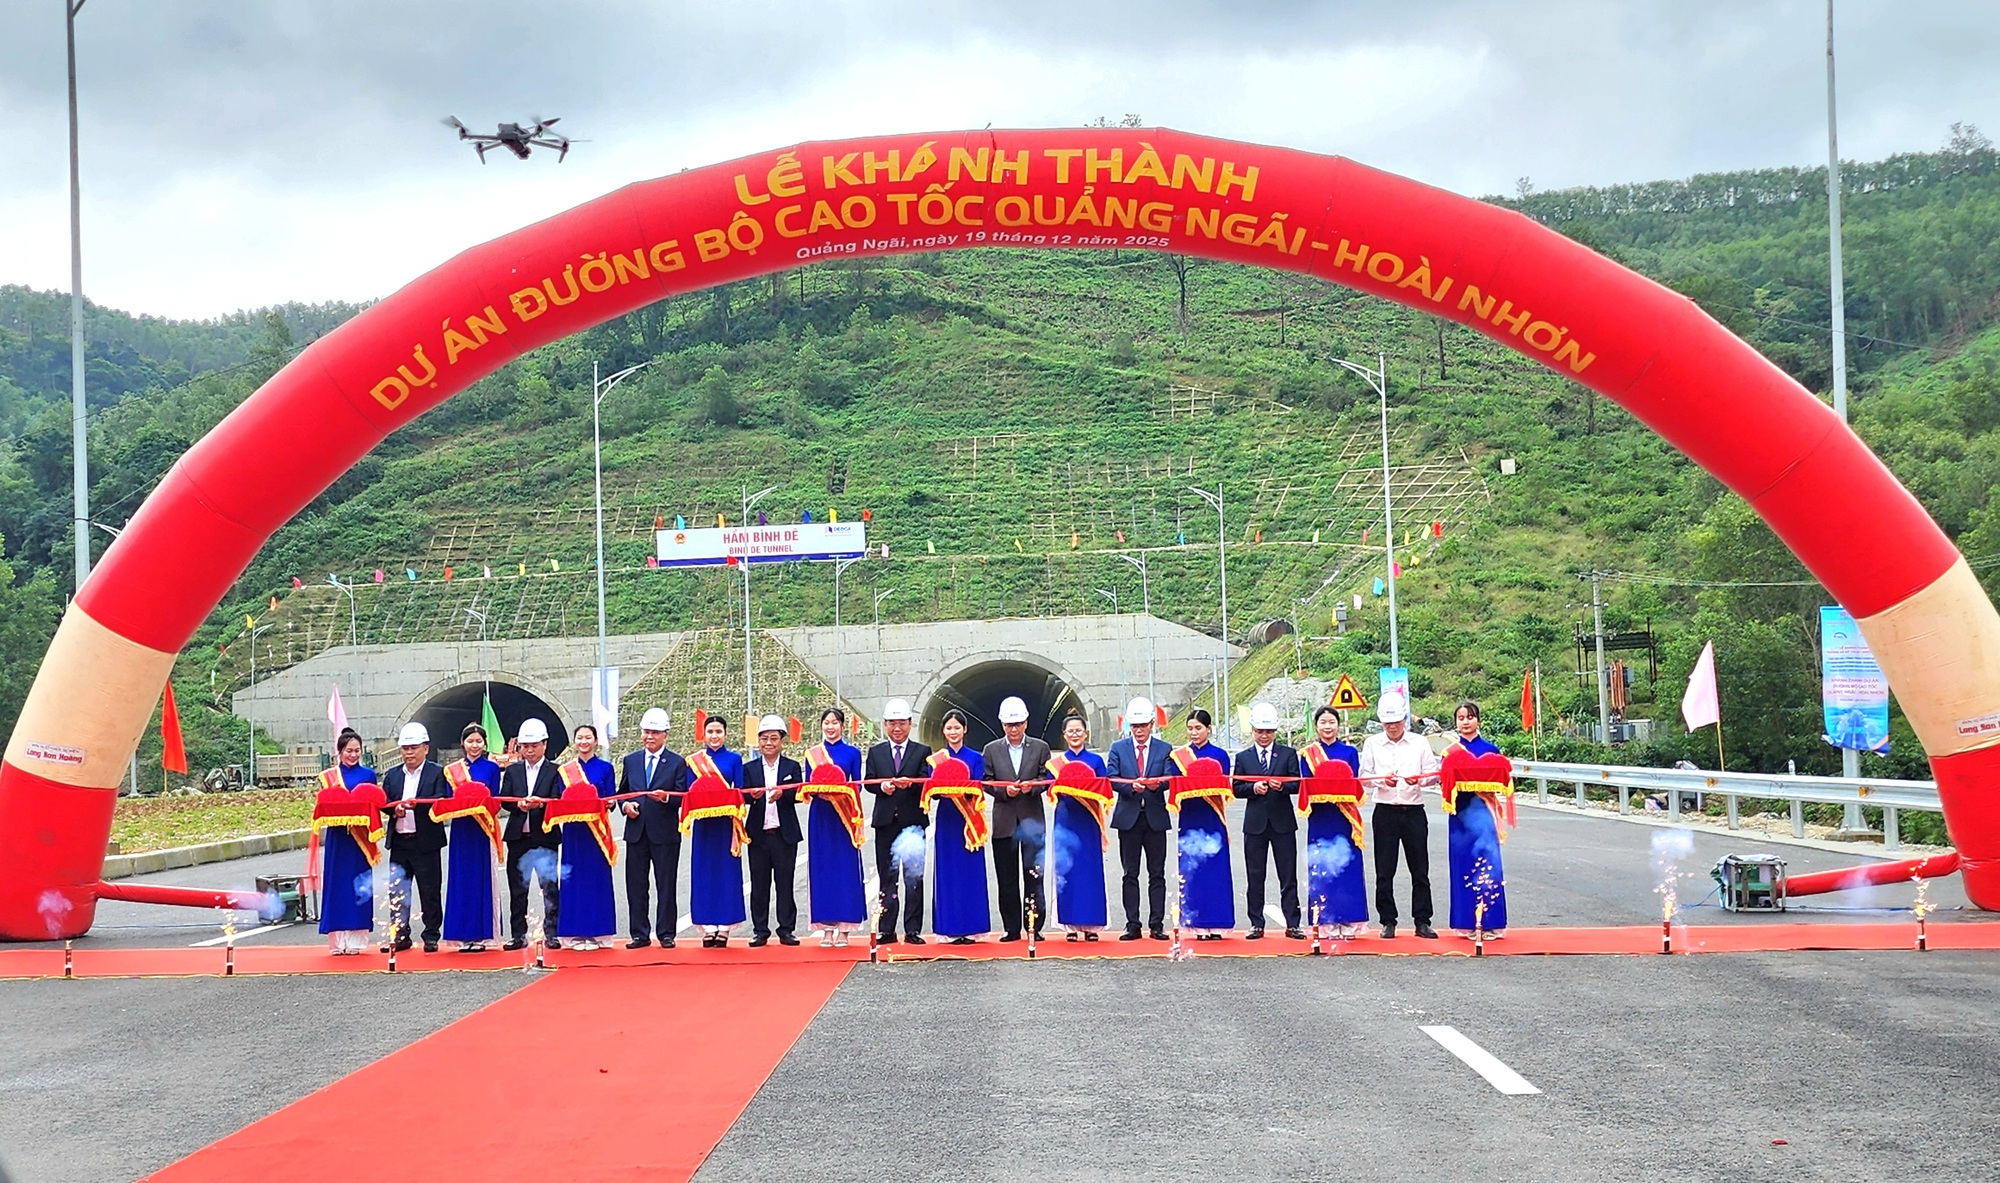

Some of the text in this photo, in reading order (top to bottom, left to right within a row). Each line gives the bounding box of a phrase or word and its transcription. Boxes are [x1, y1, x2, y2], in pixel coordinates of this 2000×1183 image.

[734, 140, 1260, 206] LỄ KHÁNH THÀNH
[796, 240, 857, 260] Quảng
[965, 231, 987, 242] 19
[991, 232, 1047, 245] tháng
[1051, 235, 1071, 244] 12
[1077, 235, 1119, 245] năm
[1124, 235, 1170, 247] 2025
[369, 343, 437, 411] DỰ
[442, 306, 507, 364] ÁN
[509, 239, 686, 322] ĐƯỜNG
[694, 211, 764, 263] BỘ
[775, 198, 876, 238] CAO
[887, 182, 984, 227] TỐC
[995, 186, 1180, 231] QUẢNG
[1457, 284, 1598, 375] NHƠN
[763, 544, 794, 554] TUNNEL
